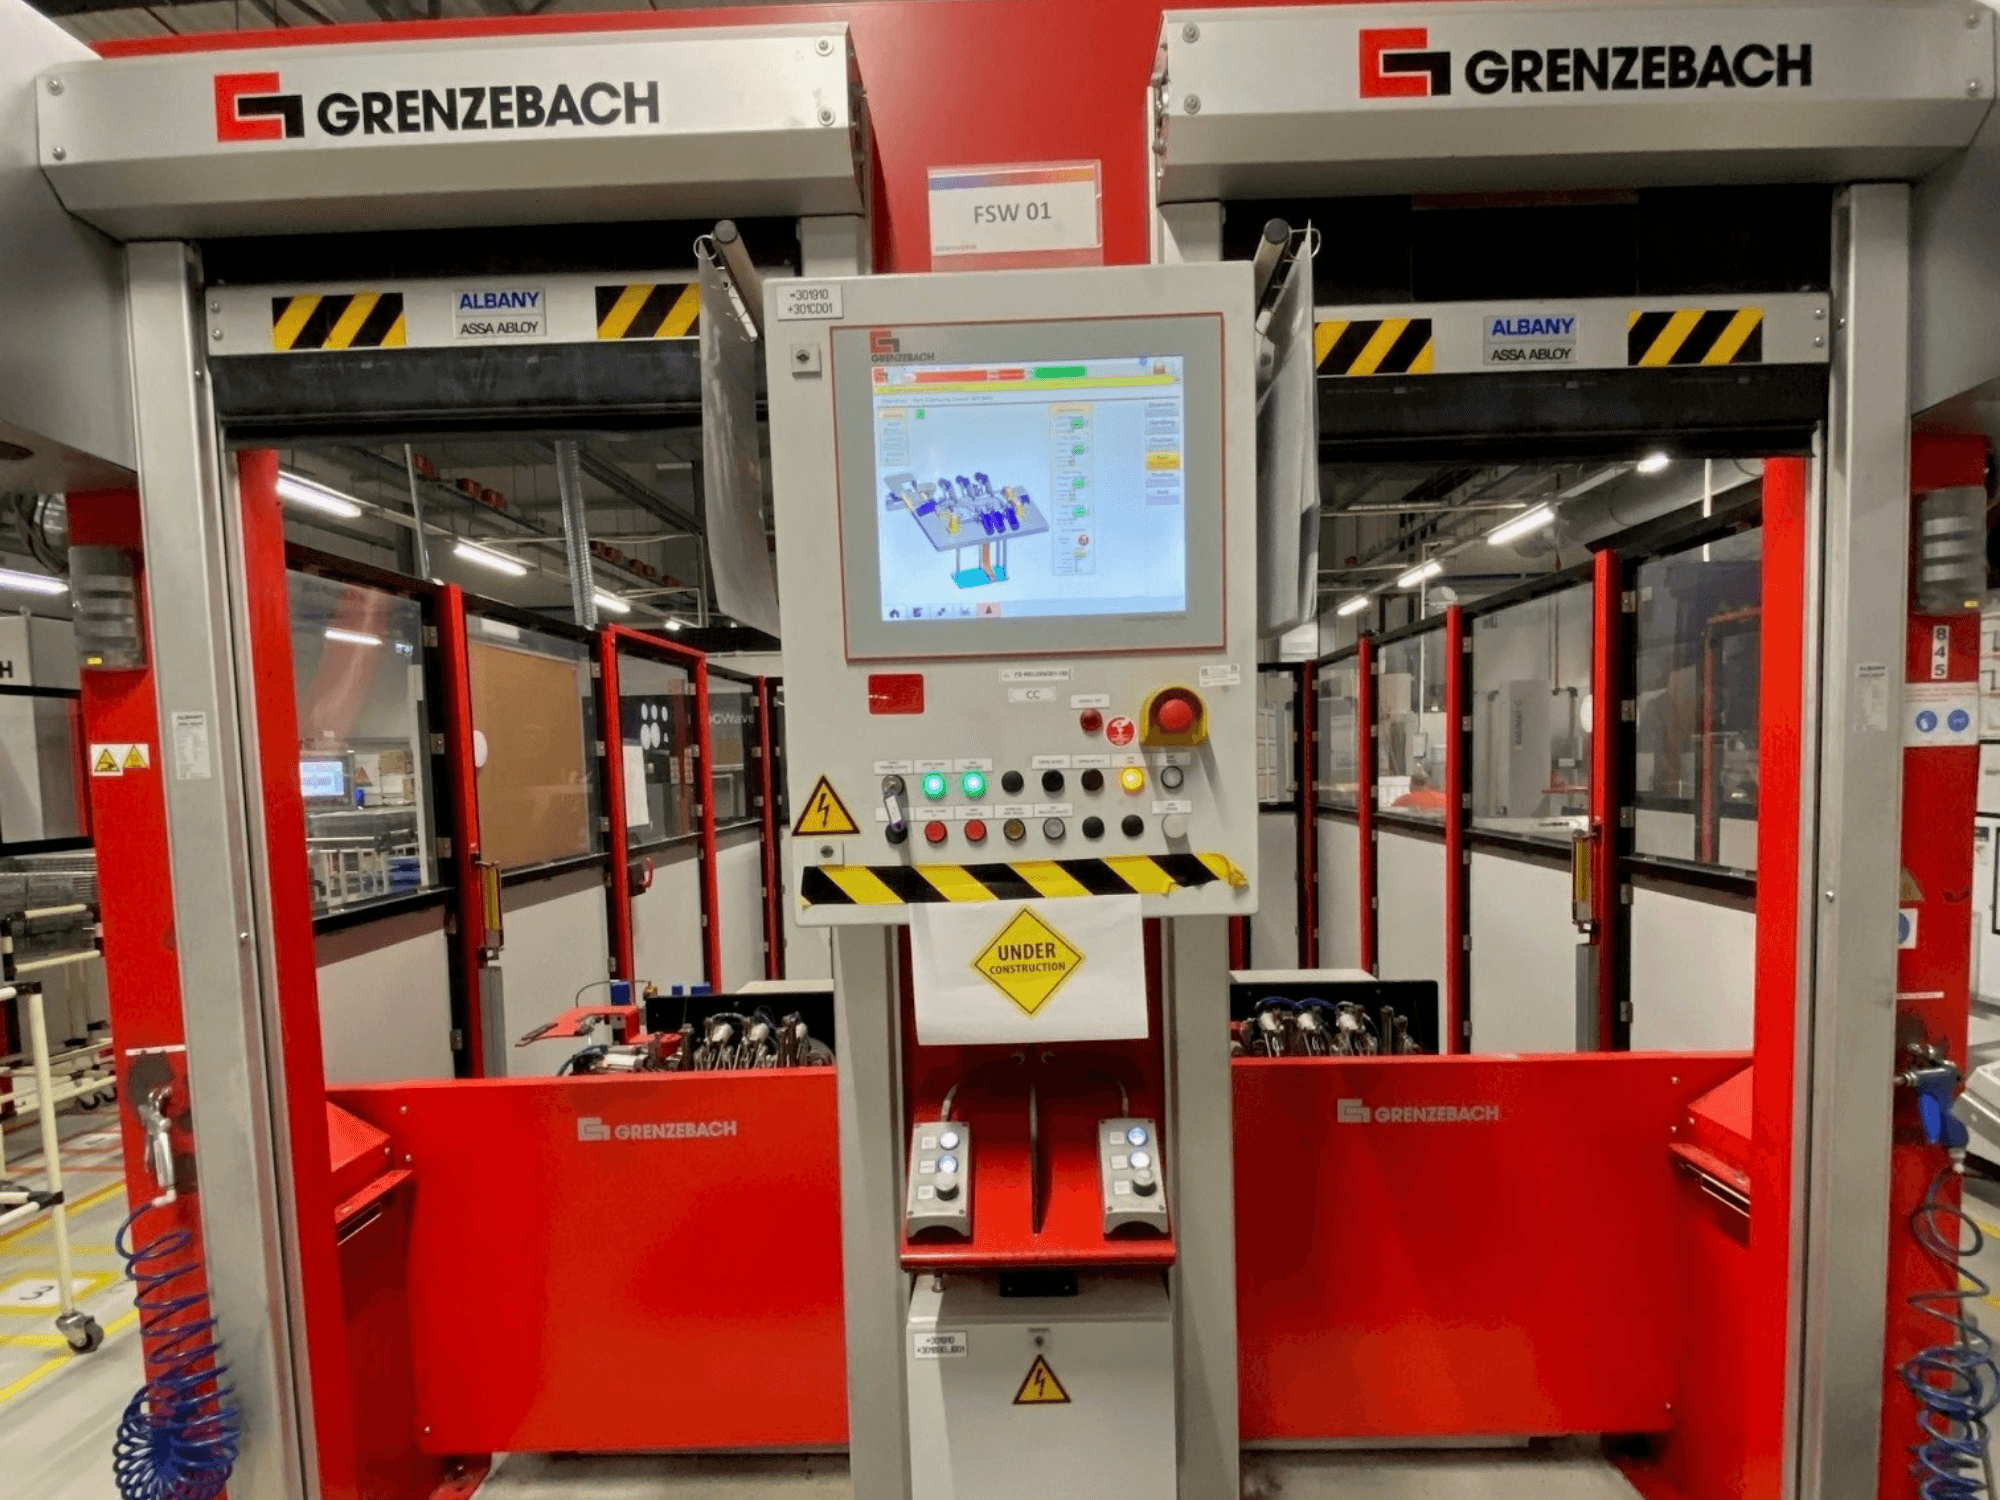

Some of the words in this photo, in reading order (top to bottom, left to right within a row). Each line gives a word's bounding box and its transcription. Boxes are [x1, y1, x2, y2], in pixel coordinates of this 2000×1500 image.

[1464, 43, 1812, 95] GRENZEBACH
[316, 80, 660, 137] GRENZEBACH
[973, 203, 1020, 224] FSW
[1026, 201, 1052, 221] 01
[459, 291, 540, 310] ALBANY
[461, 322, 495, 335] ASSA
[496, 321, 539, 334] ABLOY
[1491, 317, 1575, 336] ALBANY
[871, 352, 935, 363] GRENZEBACH
[1491, 348, 1526, 361] ASSA
[1528, 347, 1572, 360] ABLOY
[1026, 690, 1041, 700] CC
[998, 942, 1057, 961] UNDER
[989, 961, 1066, 975] CONSTRUCTION
[1374, 1105, 1500, 1124] GRENZEBACH
[614, 1120, 737, 1140] GRENZEBACH
